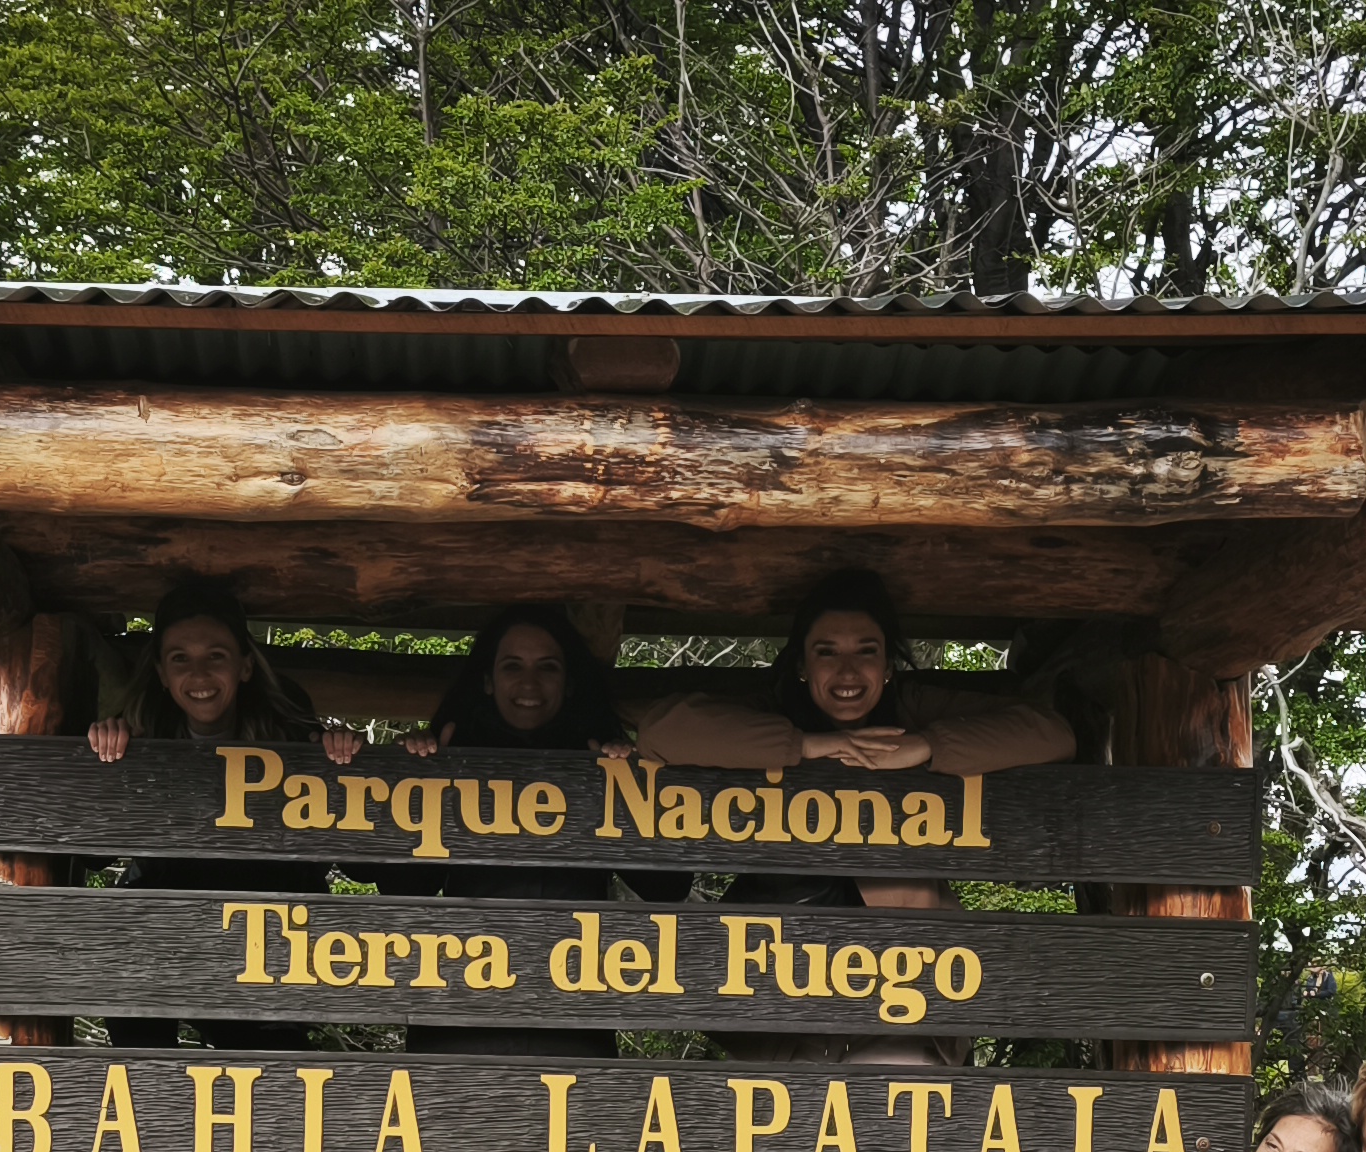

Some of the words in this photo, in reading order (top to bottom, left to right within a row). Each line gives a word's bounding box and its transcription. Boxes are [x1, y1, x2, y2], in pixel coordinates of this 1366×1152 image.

[215, 747, 567, 858] Parque
[595, 757, 991, 847] Nacional
[222, 903, 517, 988] Tierra
[549, 912, 684, 994] del
[718, 916, 983, 1024] Fuego
